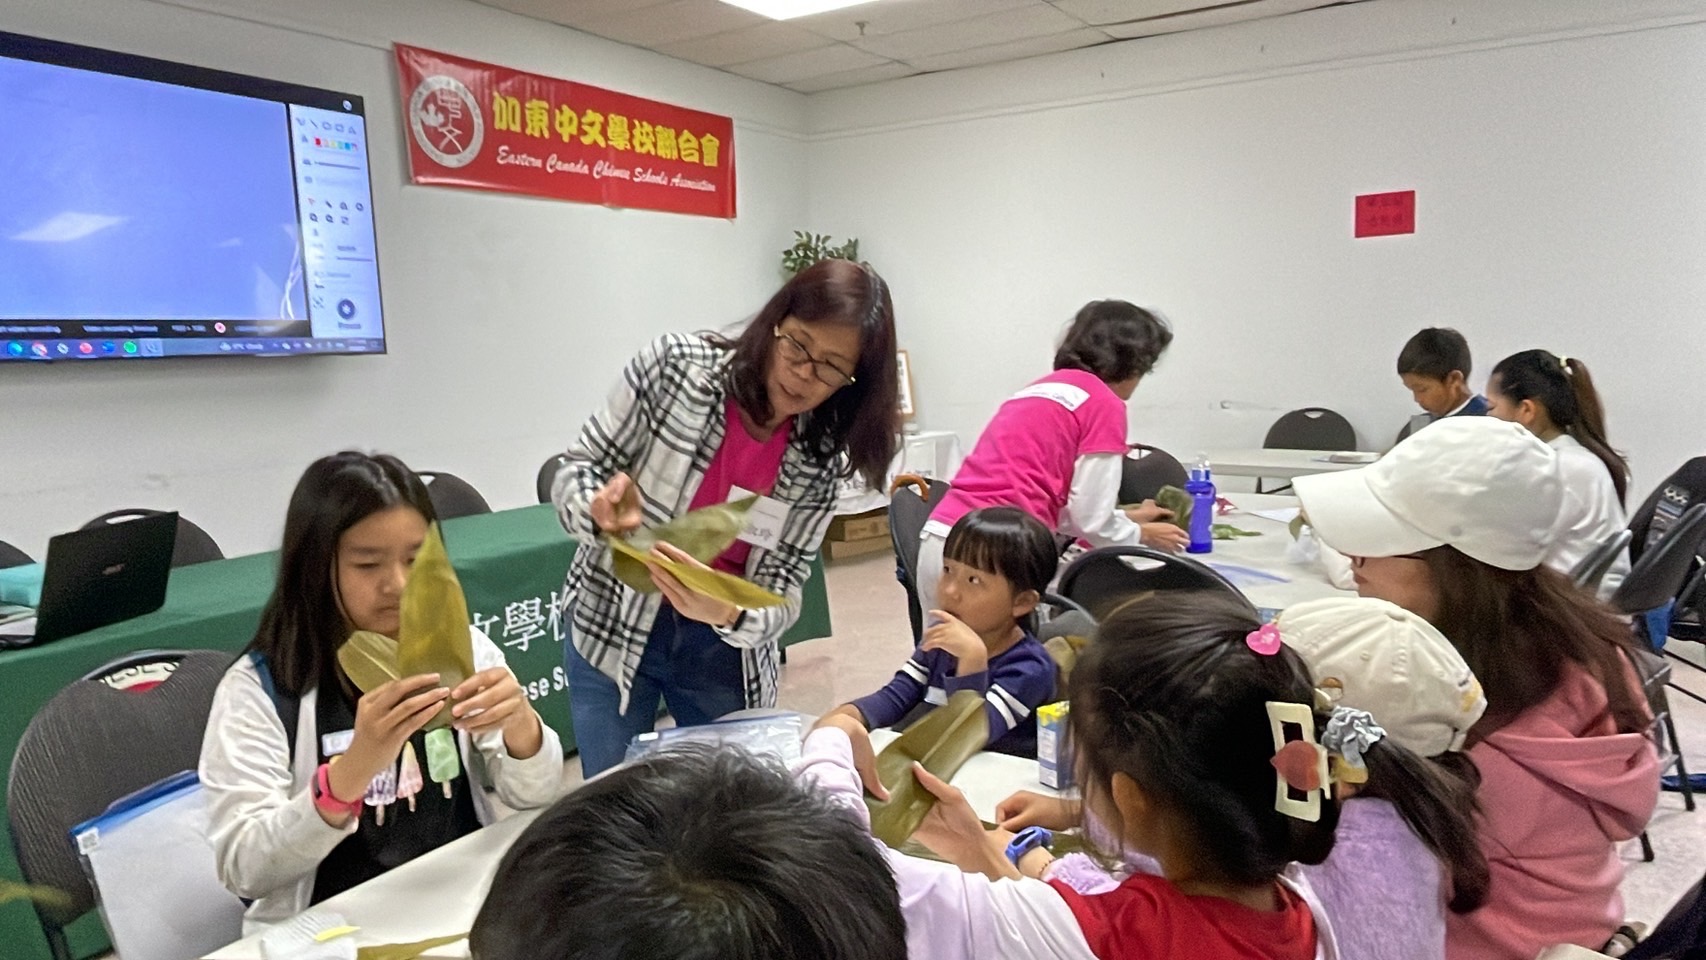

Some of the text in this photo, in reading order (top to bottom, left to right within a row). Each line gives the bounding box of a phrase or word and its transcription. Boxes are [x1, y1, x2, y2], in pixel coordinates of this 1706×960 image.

[492, 91, 719, 167] 加東中文學校聯合會
[497, 145, 716, 192] Eastern Canada Chinese Schools Association
